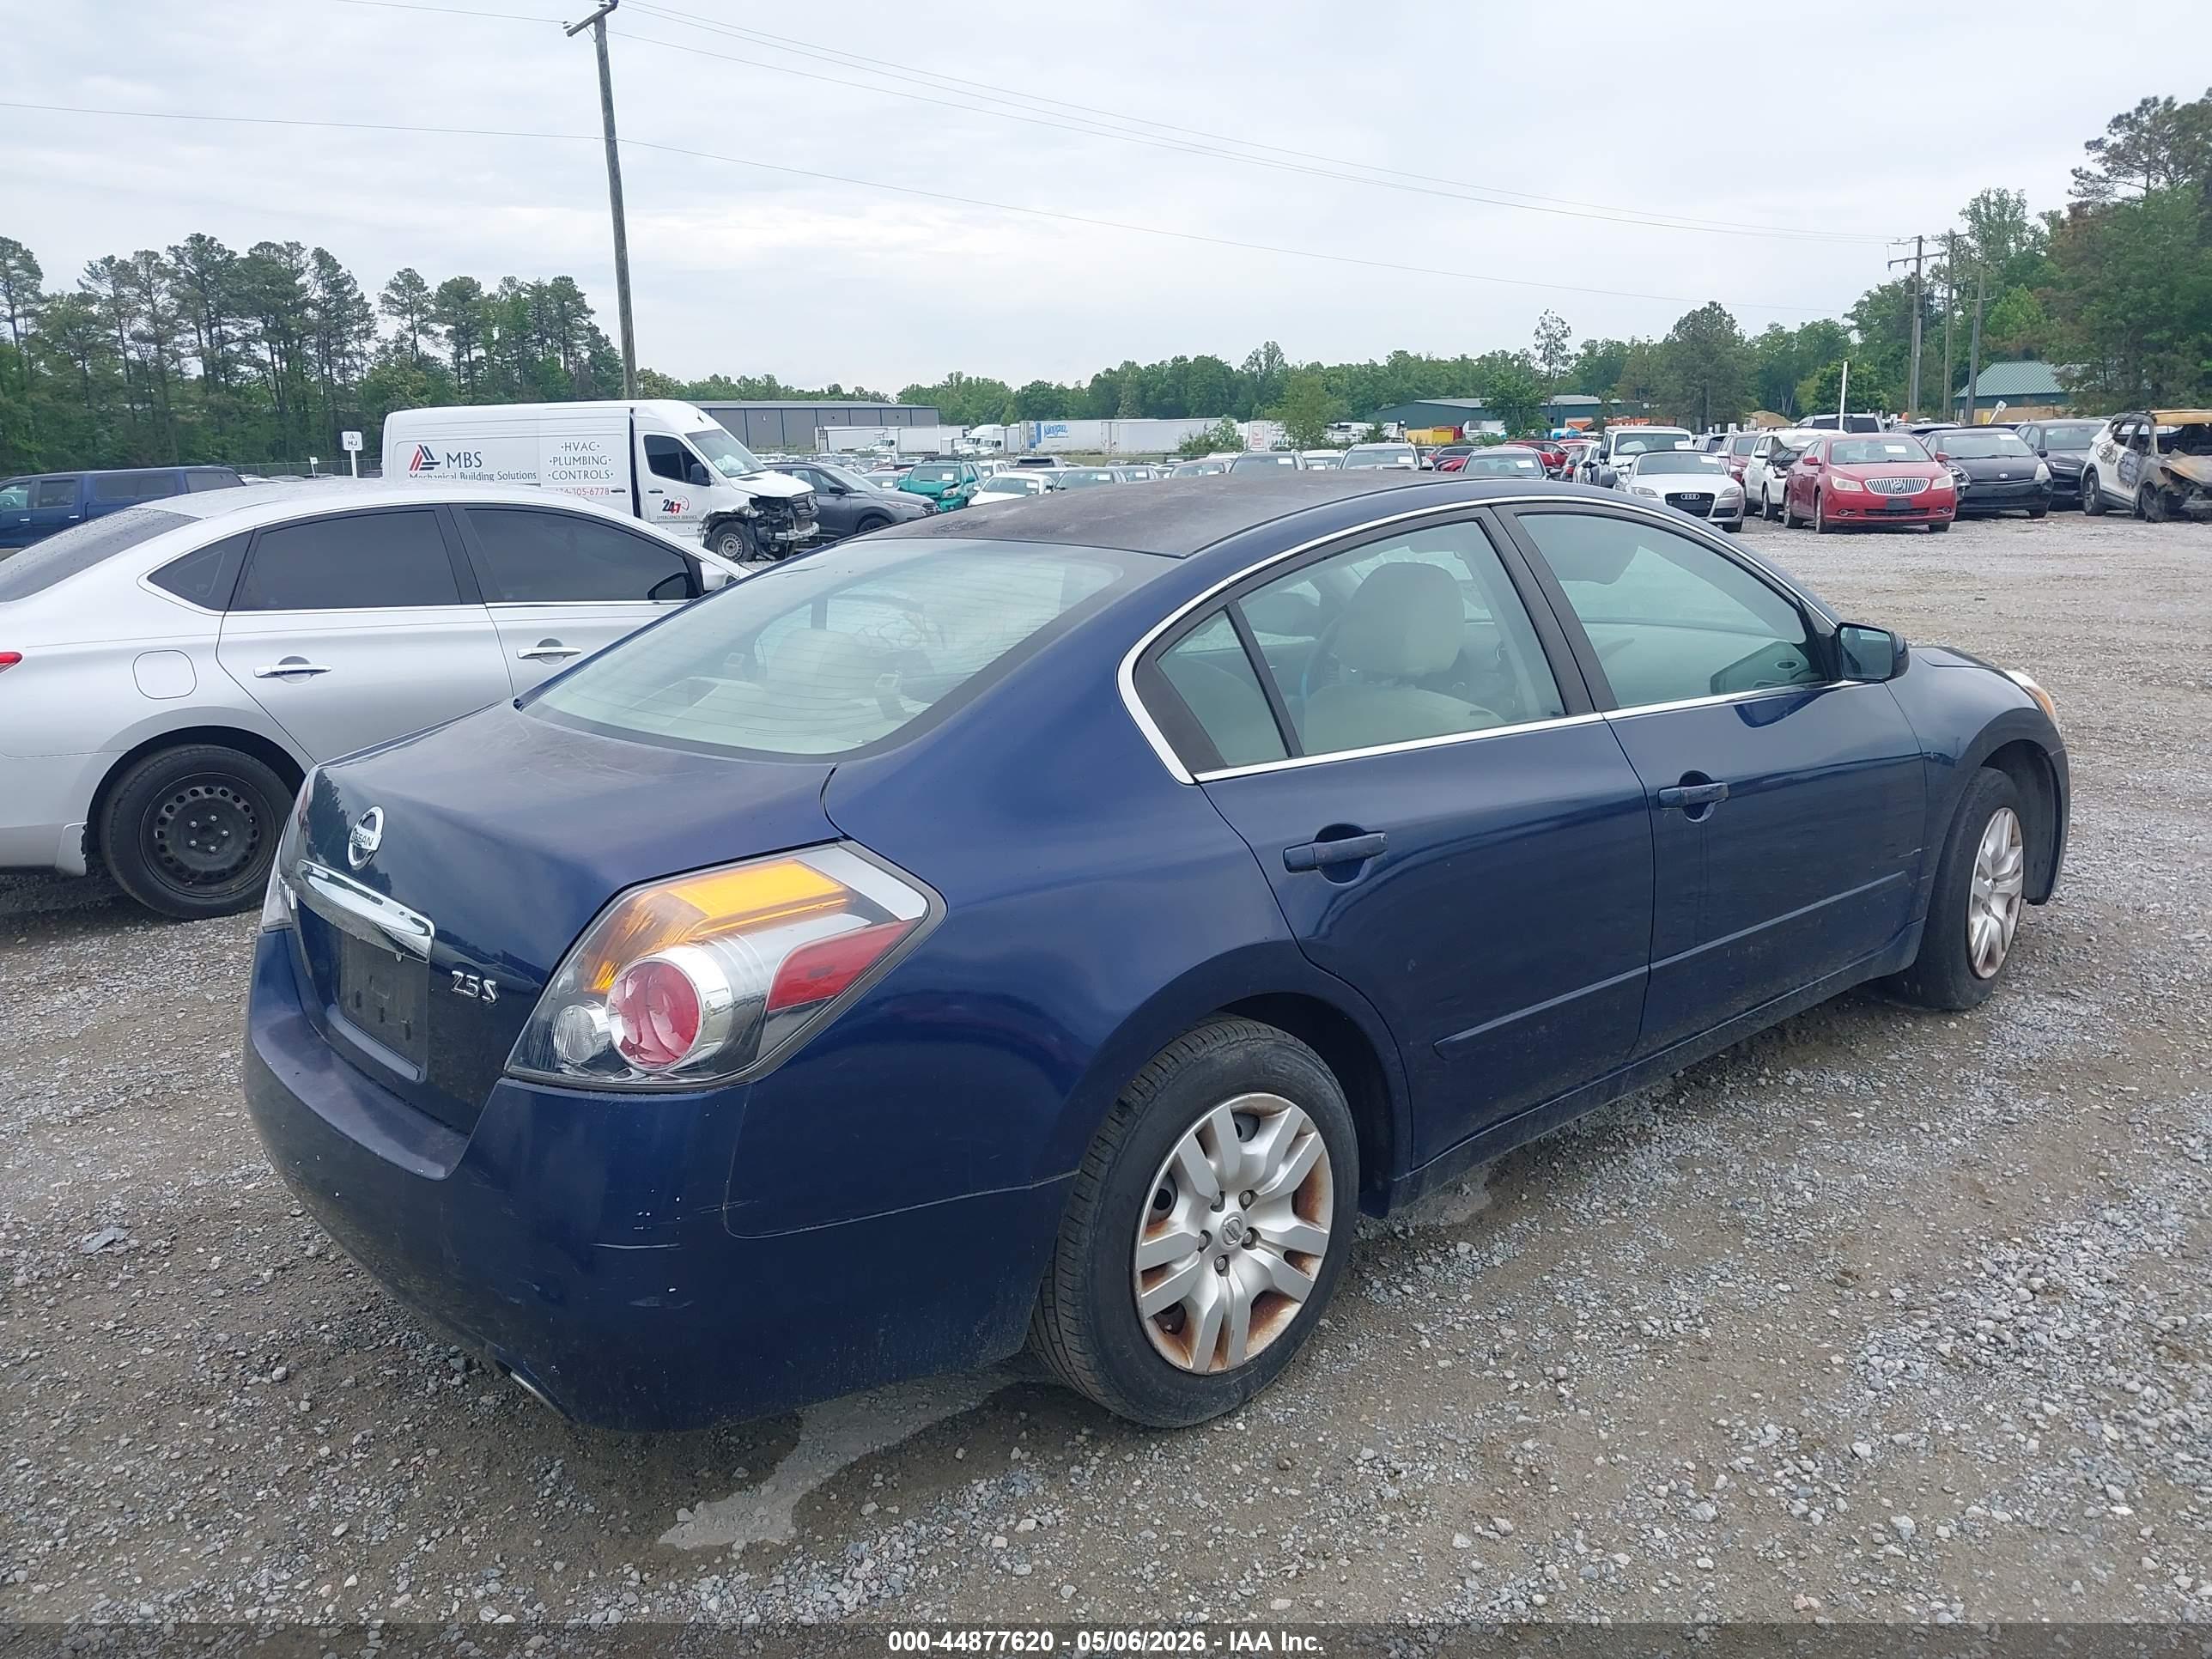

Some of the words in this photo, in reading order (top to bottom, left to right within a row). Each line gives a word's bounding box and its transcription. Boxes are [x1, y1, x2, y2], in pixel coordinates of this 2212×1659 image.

[446, 452, 483, 469] MBS
[460, 471, 495, 481] Building
[497, 471, 537, 481] Solutions
